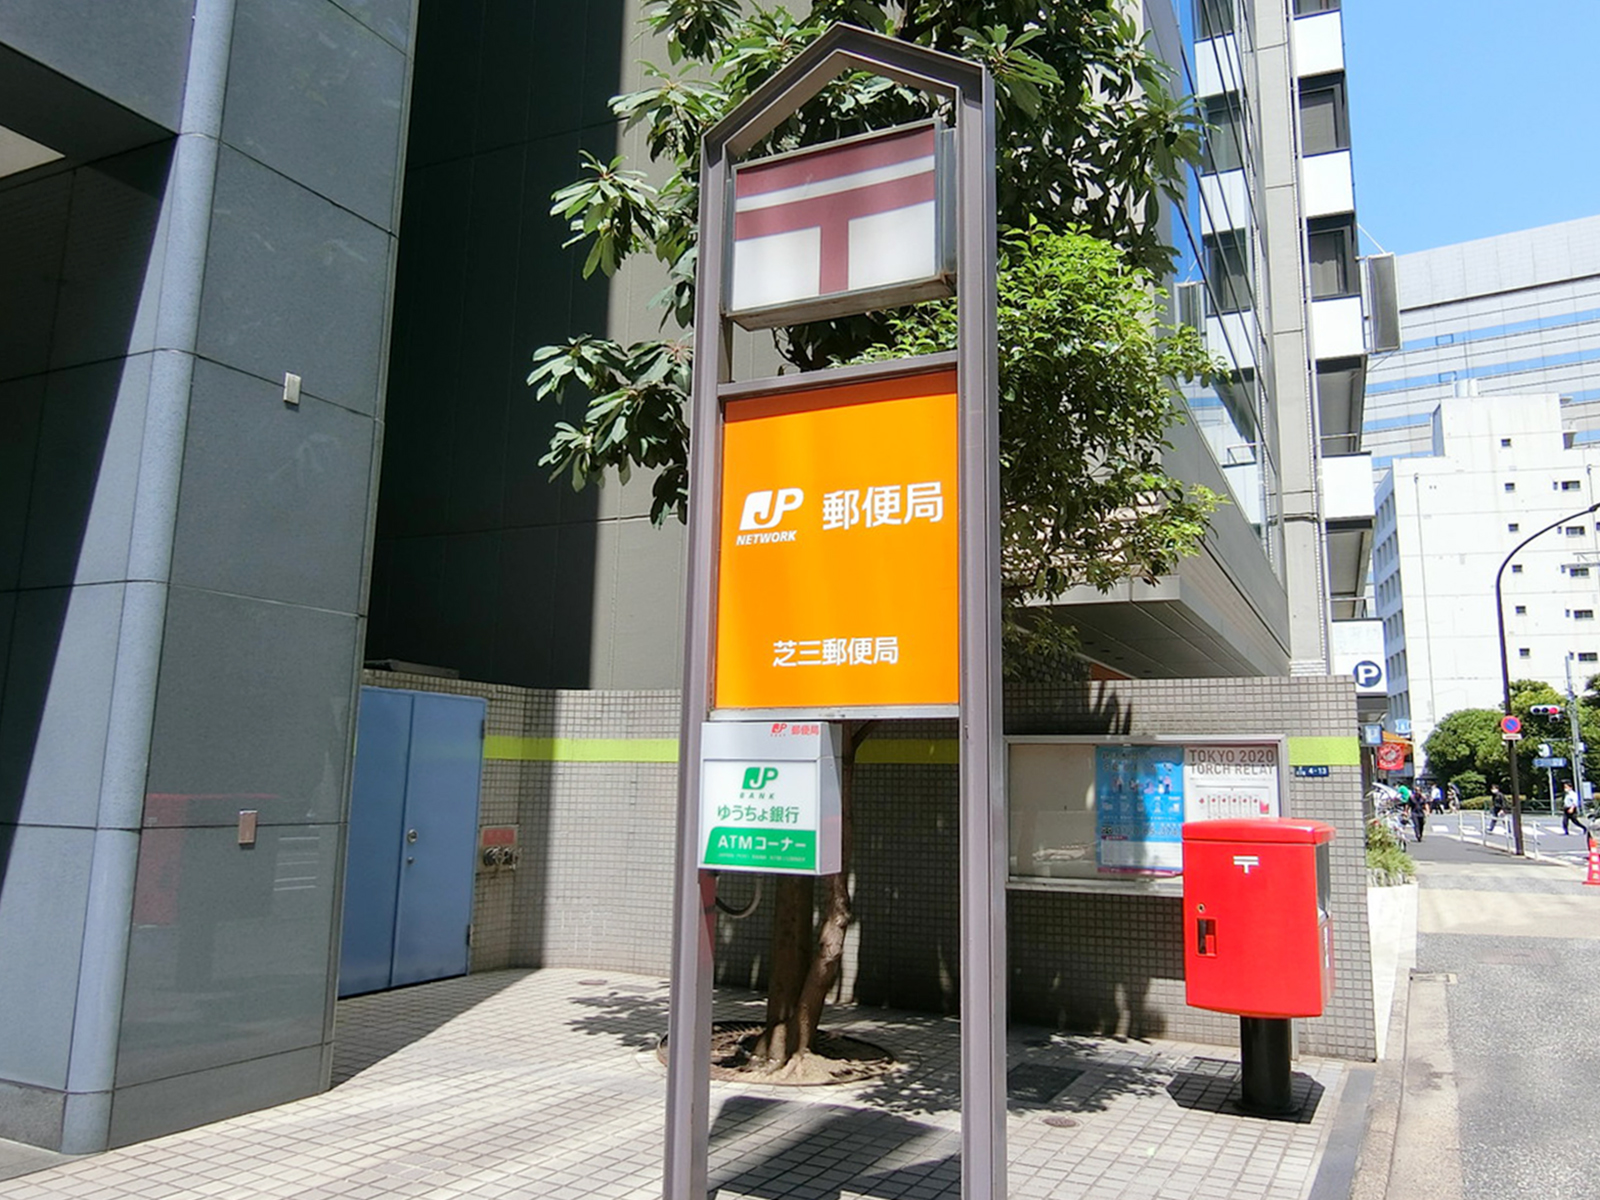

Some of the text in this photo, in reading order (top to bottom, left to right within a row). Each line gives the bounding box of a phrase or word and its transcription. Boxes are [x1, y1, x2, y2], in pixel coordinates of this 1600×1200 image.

[822, 481, 944, 530] 郵便局
[736, 530, 797, 546] NETWORK
[773, 636, 899, 667] 芝三郵便局
[1359, 666, 1379, 684] P
[791, 724, 819, 735] 郵便局
[1189, 749, 1235, 762] TOKYO
[1239, 749, 1274, 763] 2020
[1190, 763, 1275, 775] TORCH RELAY
[740, 792, 775, 800] BANK
[717, 804, 800, 824] ゆうちょ銀行
[718, 834, 806, 852] ATMコーナー
